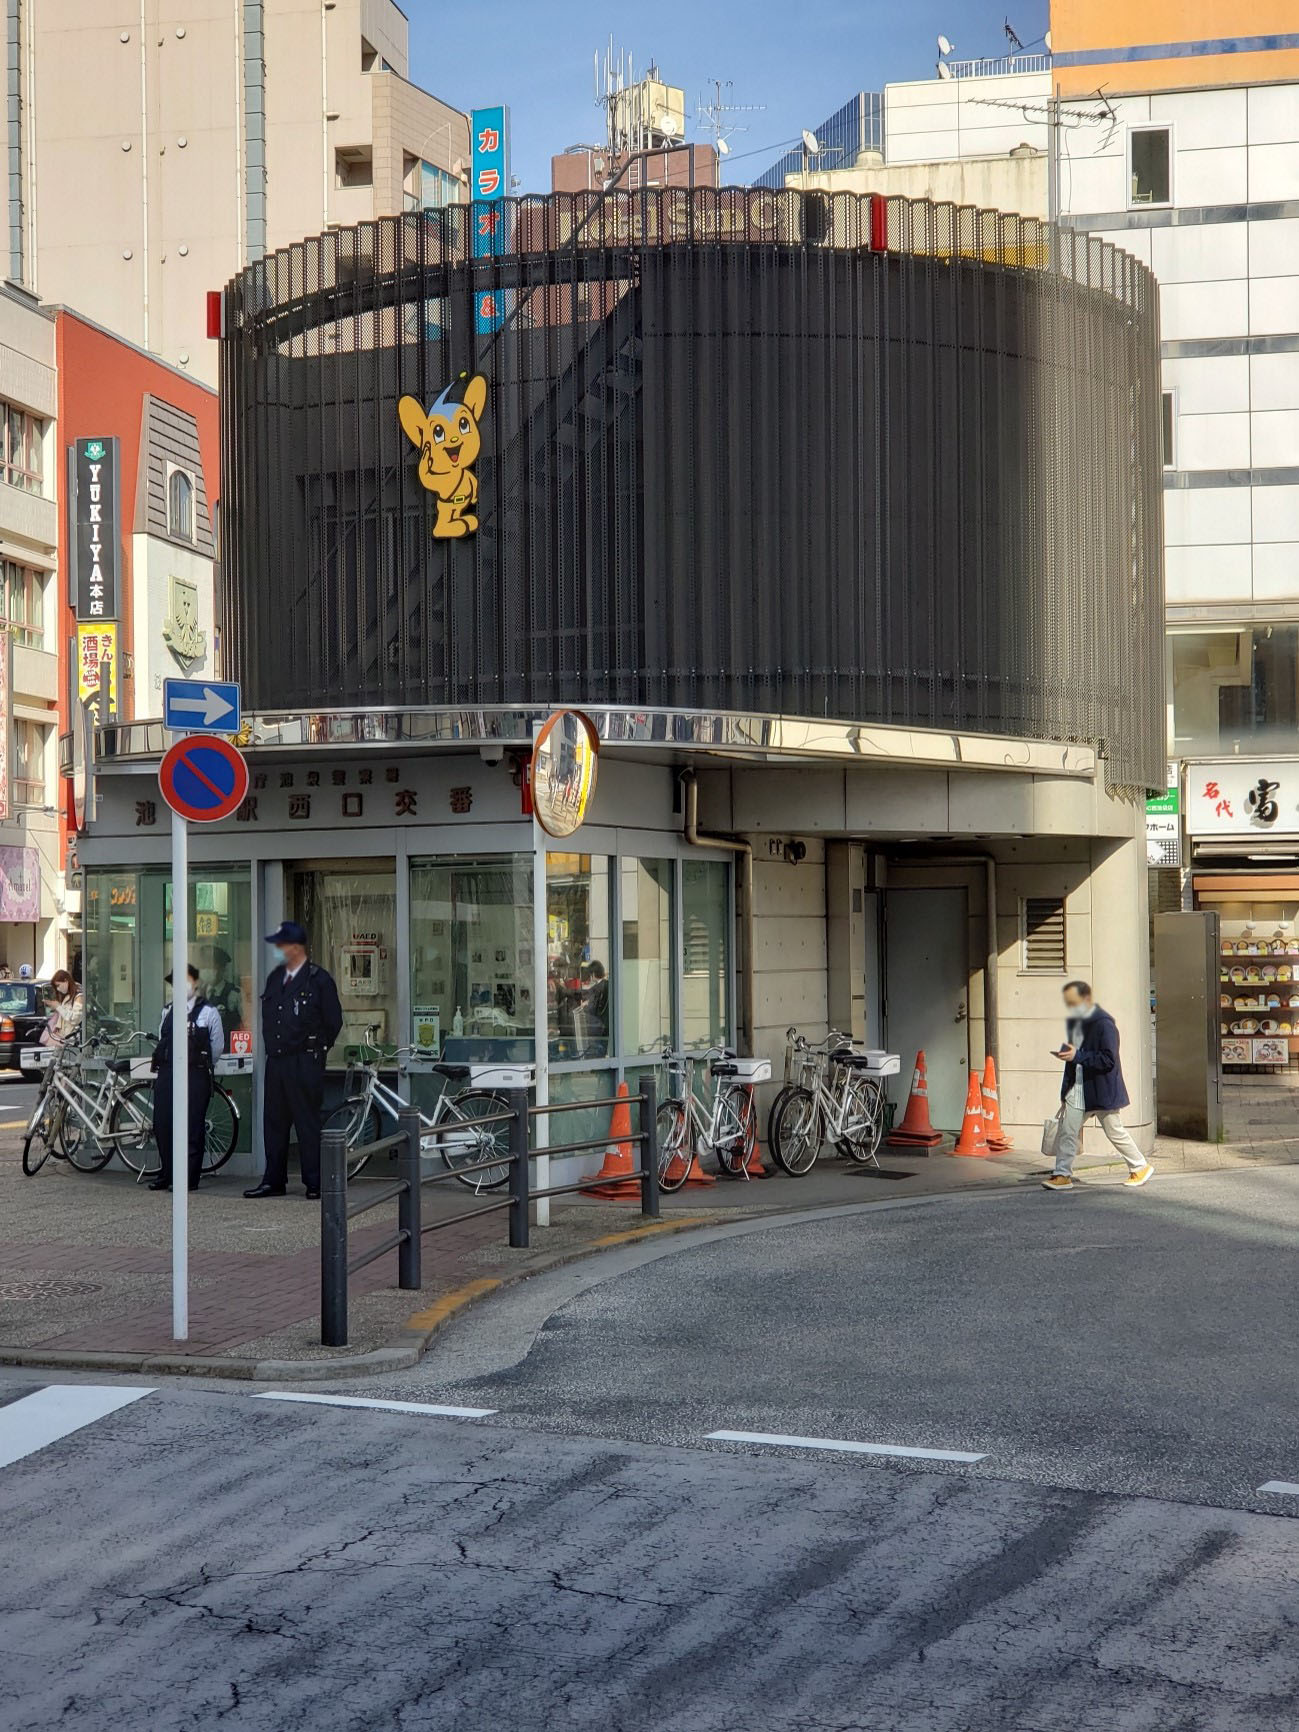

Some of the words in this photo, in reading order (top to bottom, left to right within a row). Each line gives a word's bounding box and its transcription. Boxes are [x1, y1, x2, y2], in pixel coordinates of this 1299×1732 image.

[89, 464, 104, 616] YUKIYA本店
[82, 636, 99, 669] 酒場
[136, 786, 473, 826] 池駅西口交番
[1202, 781, 1234, 818] 名代
[232, 1032, 250, 1041] AED
